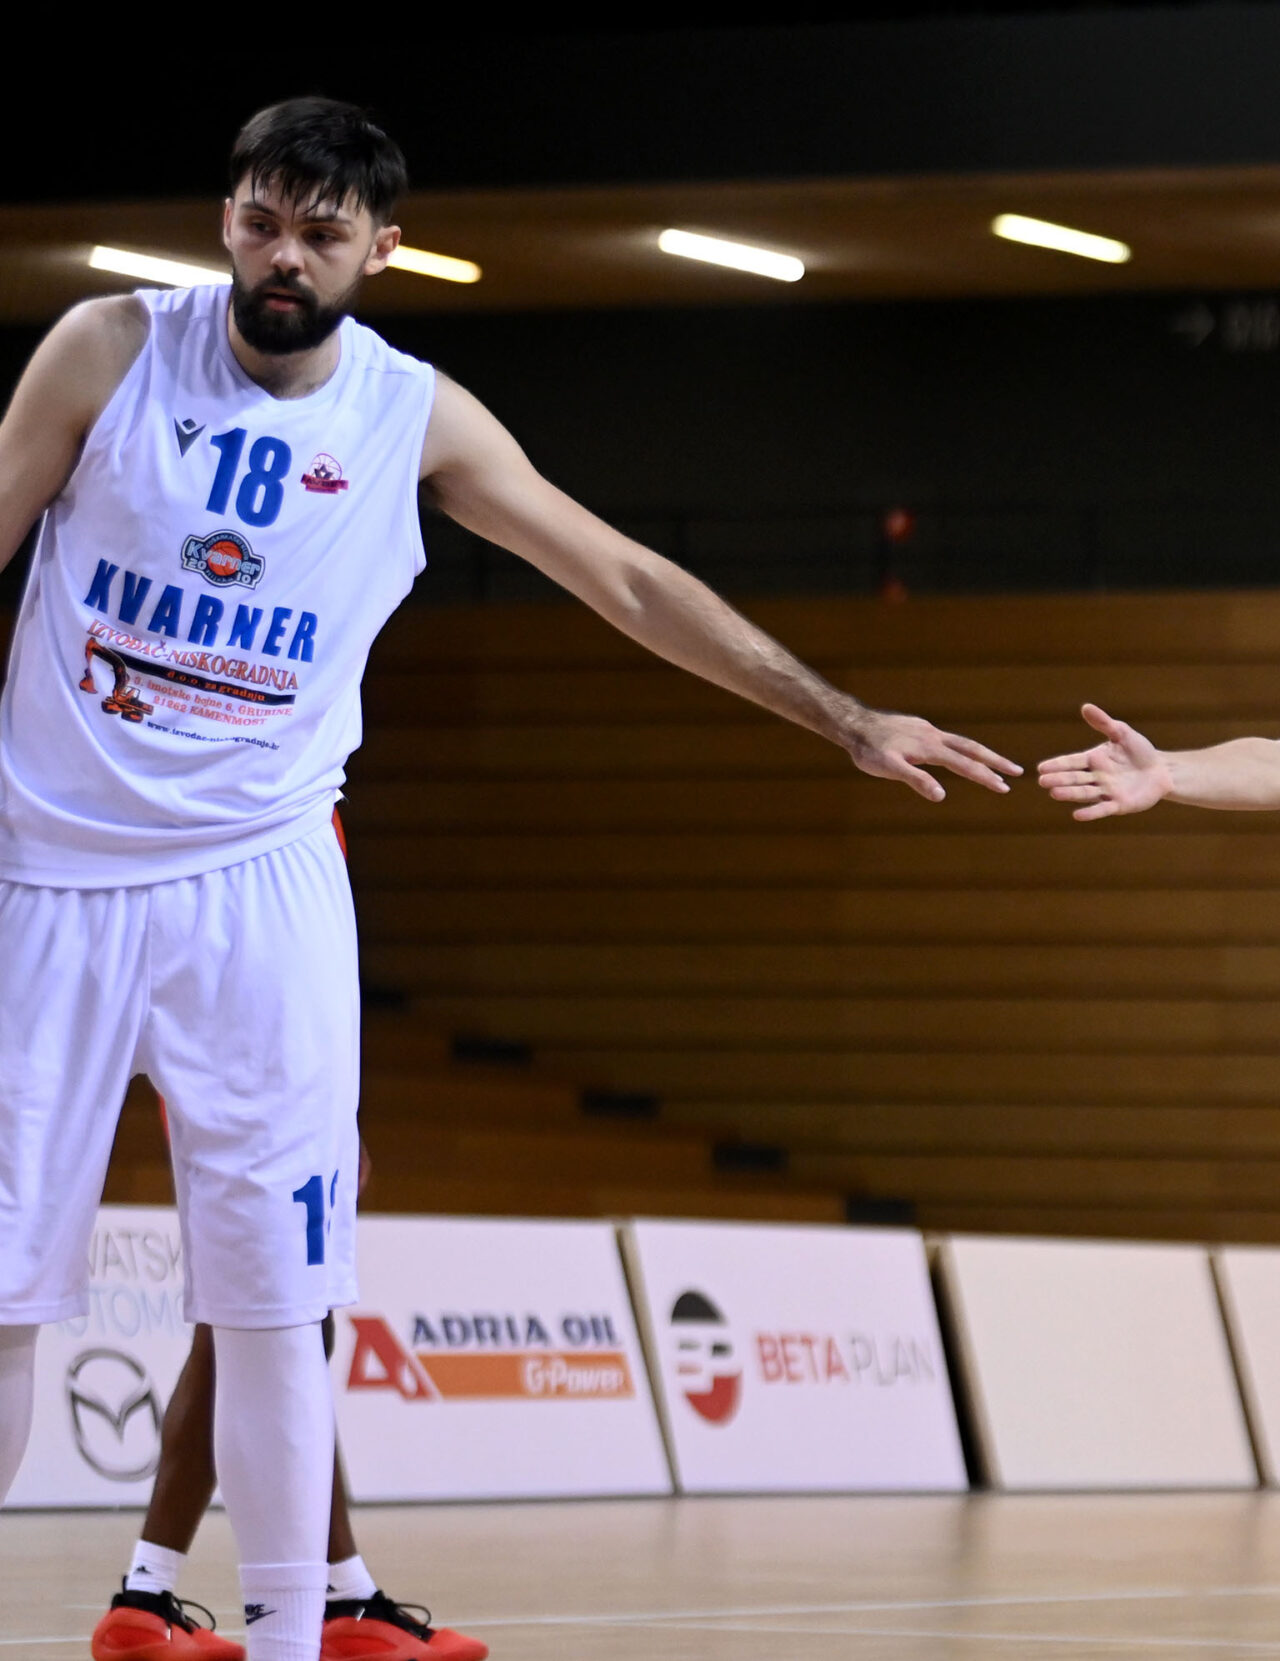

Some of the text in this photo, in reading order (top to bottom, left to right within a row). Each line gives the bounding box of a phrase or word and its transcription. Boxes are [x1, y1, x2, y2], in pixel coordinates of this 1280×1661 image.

[206, 427, 292, 528] 18
[186, 541, 260, 576] Kvarner
[187, 558, 252, 584] 20 10
[83, 558, 318, 663] KVARNER
[87, 618, 299, 691] IZVOĐAČ-NISKOGRADNJA
[204, 682, 217, 691] za
[189, 706, 267, 726] KAMENMOST
[292, 1169, 339, 1266] 1
[412, 1314, 619, 1346] ADRIA OIL
